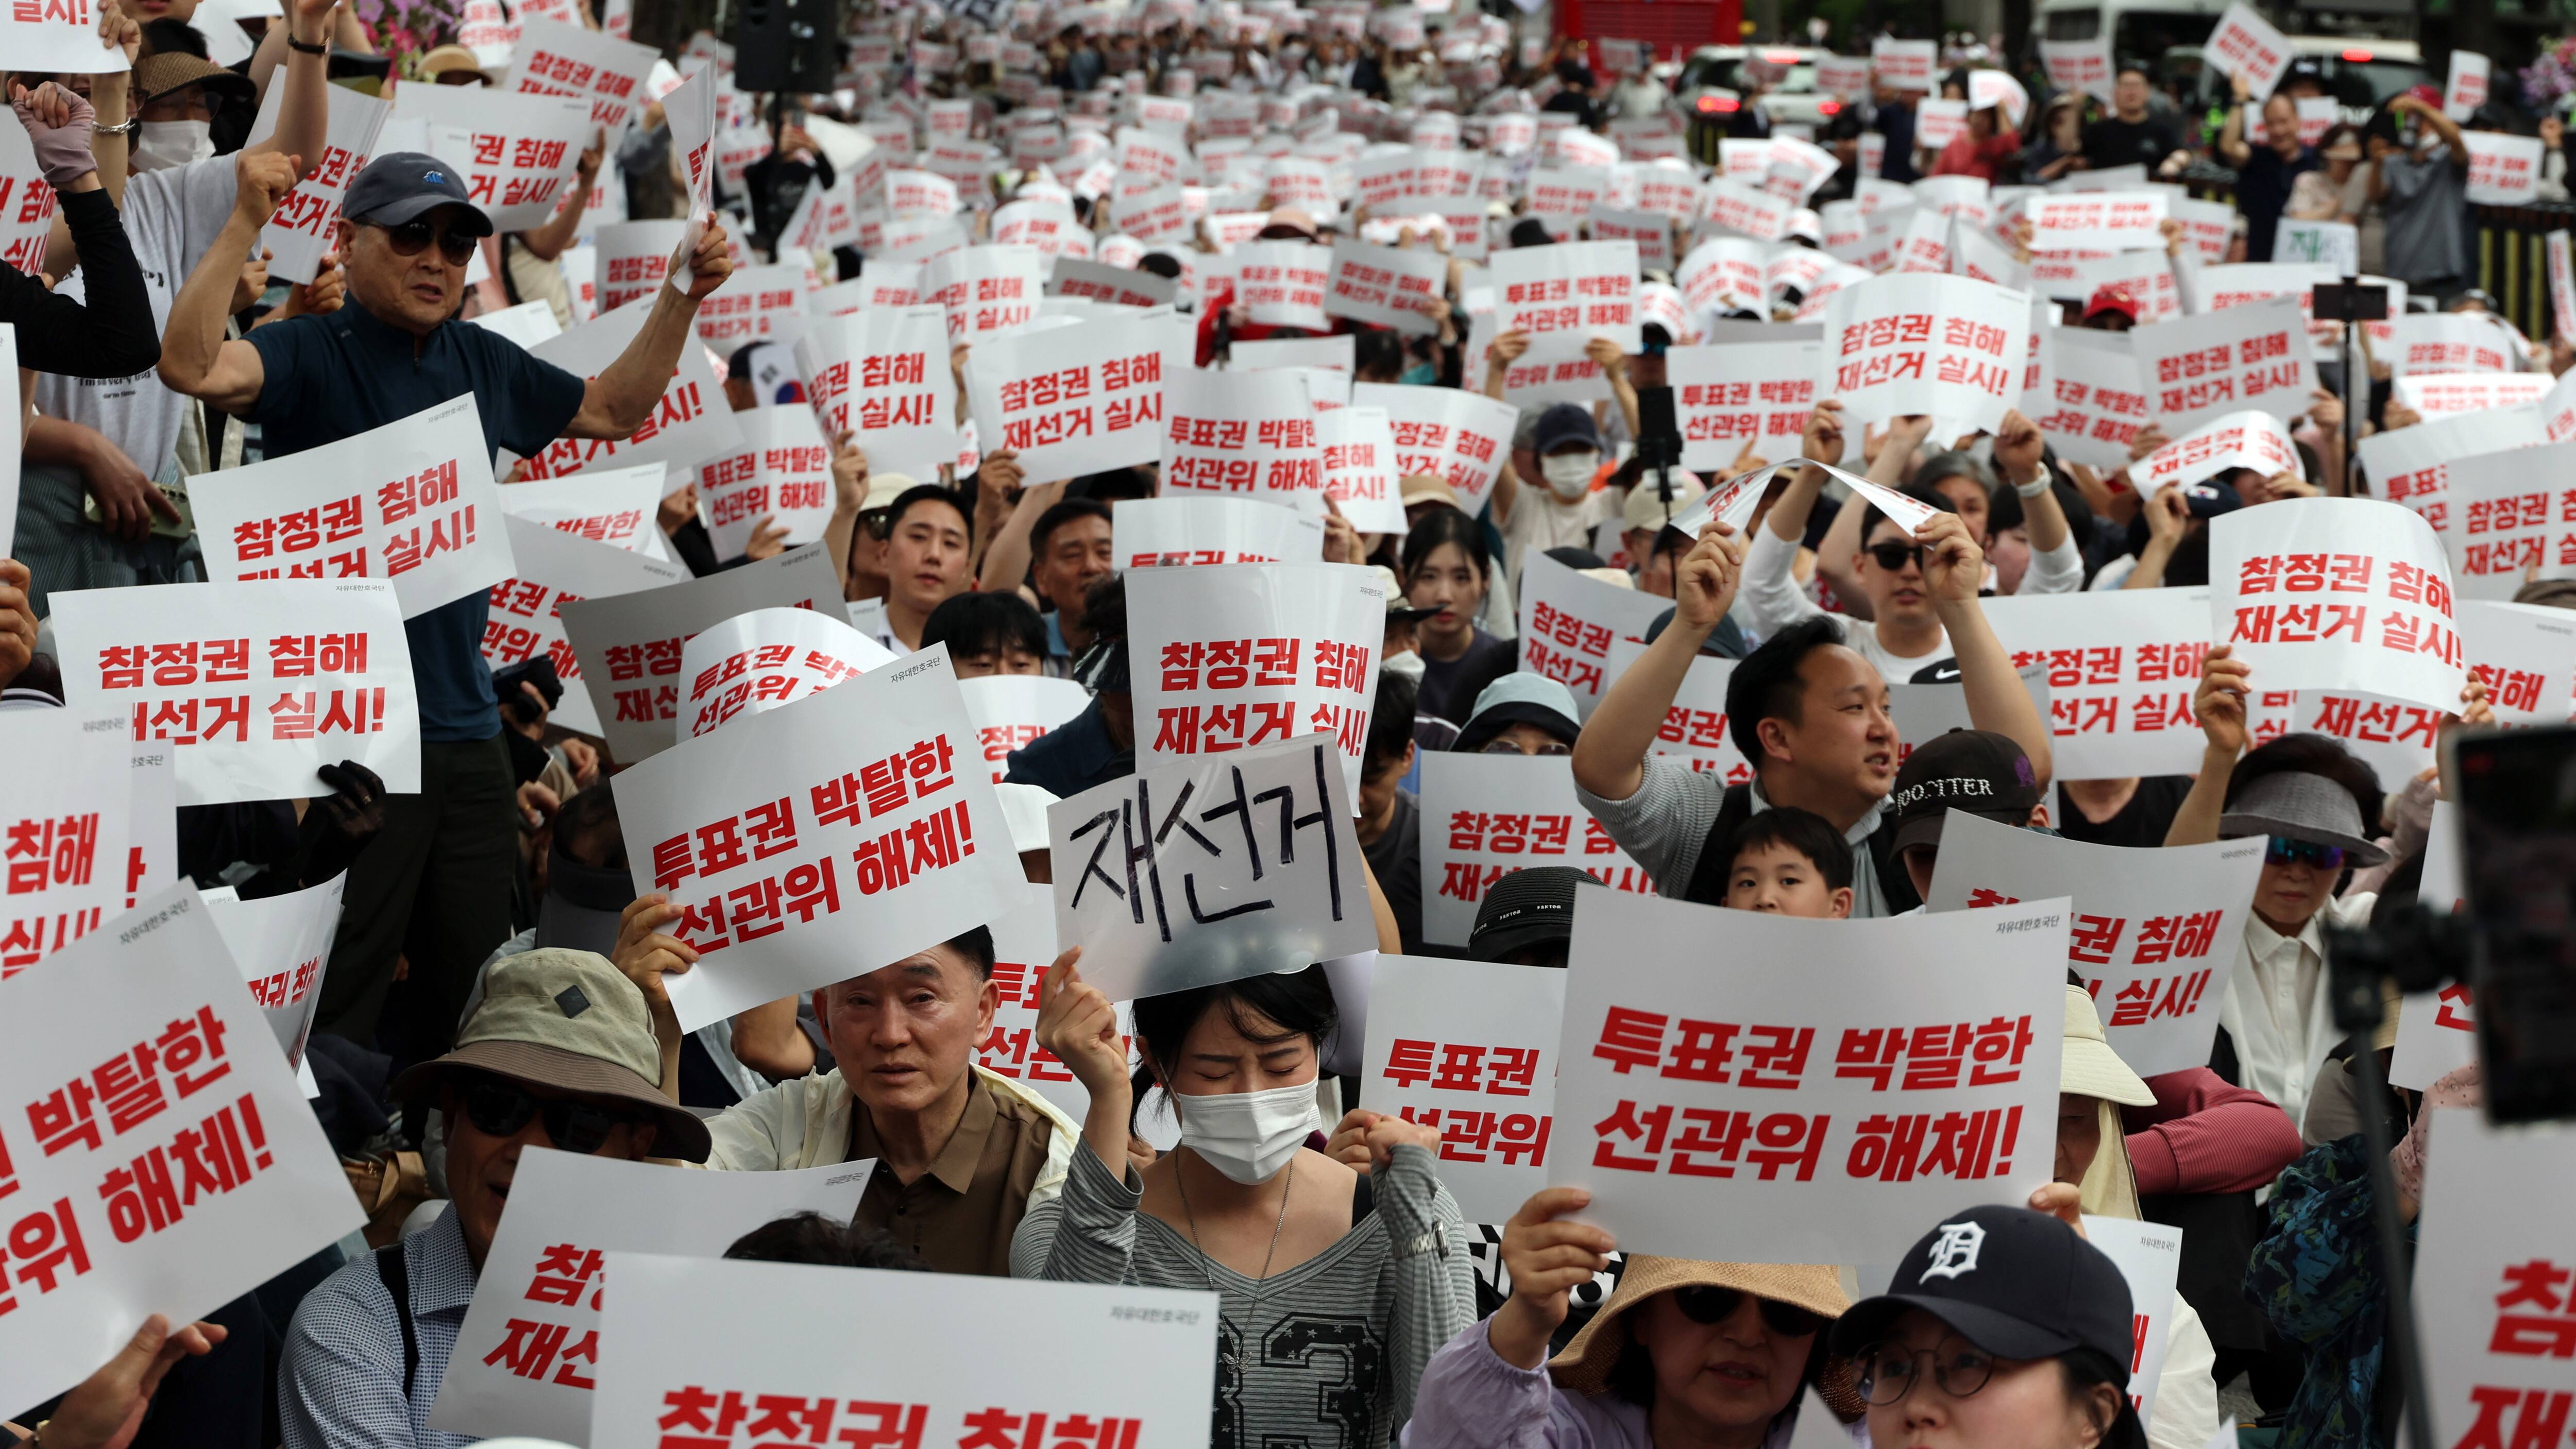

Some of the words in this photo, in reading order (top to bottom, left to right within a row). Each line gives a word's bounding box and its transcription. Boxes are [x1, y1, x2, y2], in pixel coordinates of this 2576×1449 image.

[514, 139, 567, 168] 침해
[503, 179, 558, 206] 실시!
[1507, 280, 1569, 303] 투표권
[1577, 276, 1630, 296] 박탈한
[1512, 306, 1580, 334] 선관위
[1588, 304, 1631, 325] 해체!
[1842, 315, 1933, 358] 참정권
[1941, 318, 2006, 361] 침해
[862, 353, 924, 387] 침해
[1502, 365, 1549, 389] 관위
[1838, 349, 1926, 390] 재선거
[1938, 353, 2008, 396] 실시!
[2159, 346, 2230, 383] 참정권
[2241, 332, 2288, 364] 침해
[1002, 367, 1089, 412] 참정권
[1102, 352, 1160, 391] 침해
[1682, 383, 1751, 407] 투표권
[1759, 381, 1813, 403] 박탈한
[2161, 378, 2233, 412] 재선거
[2244, 362, 2298, 396] 실시!
[428, 403, 468, 423] 자유대한호국단
[861, 394, 934, 429] 실시!
[1002, 406, 1092, 455] 재선거
[1170, 416, 1248, 449] 투표권
[1687, 414, 1760, 442] 선관위
[1324, 445, 1374, 470] 침해
[1390, 422, 1448, 448] 정권
[1456, 430, 1496, 462] 침해
[703, 453, 756, 490] 투표권
[766, 447, 826, 473] 박탈한
[1171, 456, 1258, 491] 선관위
[1324, 476, 1385, 505] 실시!
[234, 496, 363, 560] 참정권
[378, 459, 457, 525] 침해
[713, 486, 769, 526] 선관위
[780, 482, 825, 509] 해체!
[2468, 493, 2549, 534] 참정권
[383, 505, 475, 577] 실시!
[2463, 536, 2545, 574] 재선거
[2240, 554, 2371, 595] 참정권
[2383, 562, 2452, 623] 침해
[1533, 602, 1613, 657] 참정권
[2230, 604, 2365, 643] 재선거
[2382, 608, 2473, 672] 실시!
[99, 639, 249, 689] 참정권
[270, 633, 367, 677] 침해
[605, 637, 682, 681] 참정
[691, 645, 794, 700] 투표권
[891, 656, 940, 683] 자유대한호국단
[1161, 639, 1300, 691] 참정권
[1315, 640, 1368, 693] 침해
[269, 688, 384, 739] 실시!
[613, 685, 679, 722] 재선
[693, 676, 799, 737] 선관위
[1154, 702, 1295, 754] 재선거
[654, 797, 798, 890] 투표권
[811, 734, 953, 826] 박탈한
[1450, 811, 1571, 855] 참정권
[6, 813, 99, 894] 침해
[1069, 744, 1343, 944] 재선거
[674, 856, 840, 956] 선관위
[854, 800, 975, 895] 해체!
[1996, 915, 2059, 933] 자유대한호국단
[2133, 910, 2223, 964] 침해
[2110, 969, 2211, 1026] 실시!
[1384, 1039, 1539, 1096] 투표권
[1593, 1006, 1815, 1089] 투표권
[1836, 1016, 2033, 1091] 박탈한
[27, 1005, 229, 1156] 박탈한
[1593, 1100, 1830, 1181] 선관위
[1847, 1105, 2023, 1182] 해체!
[99, 1093, 273, 1242] 해체!
